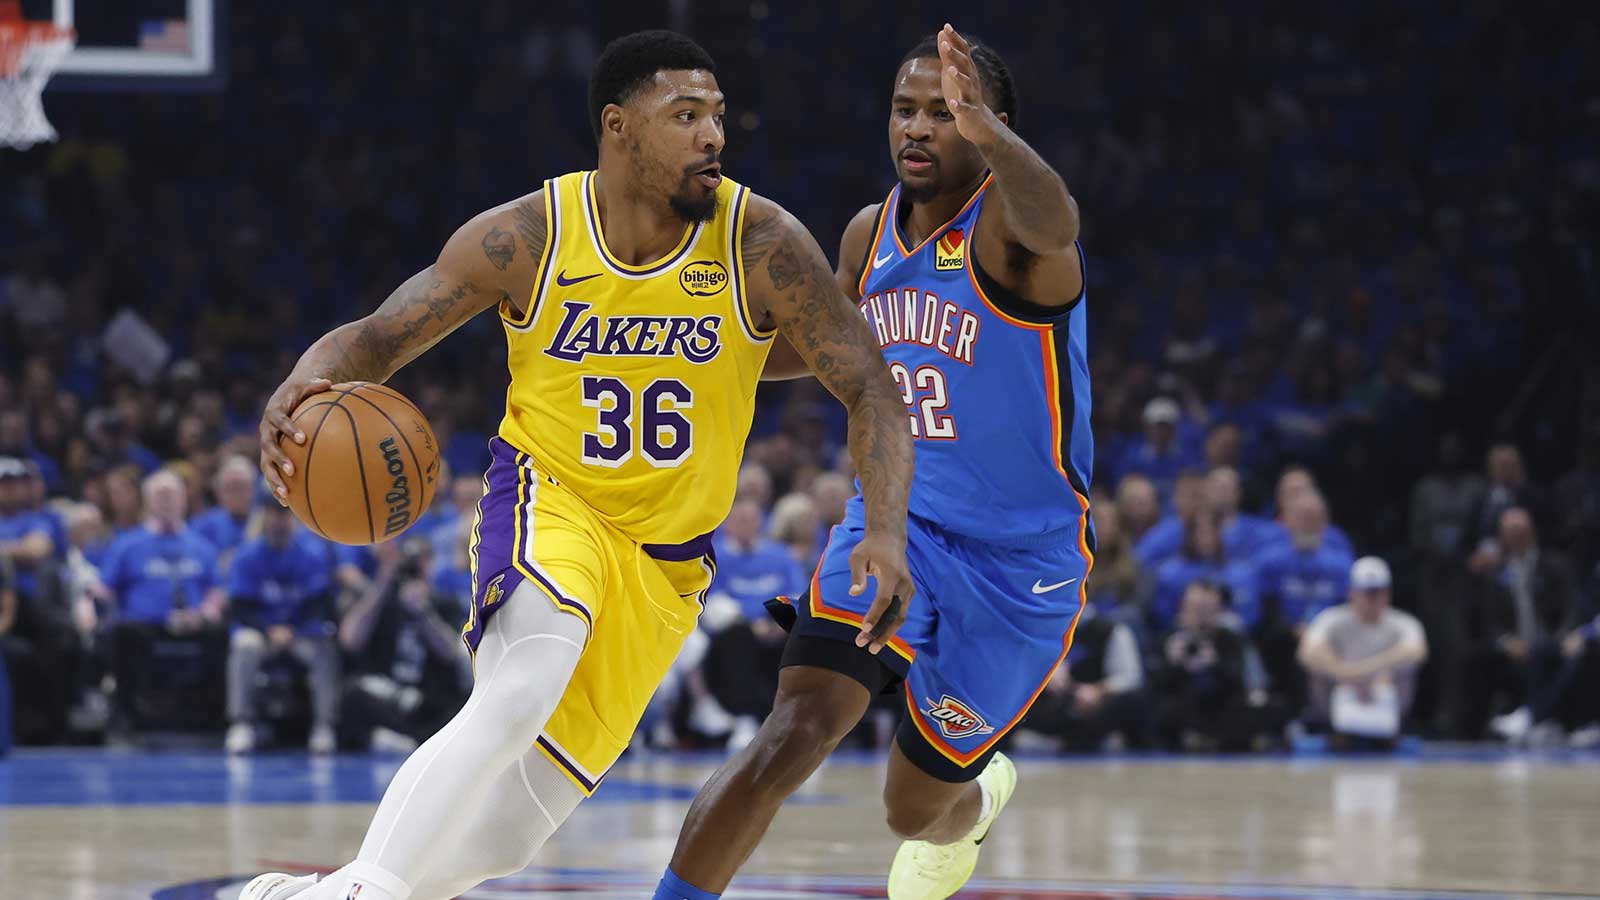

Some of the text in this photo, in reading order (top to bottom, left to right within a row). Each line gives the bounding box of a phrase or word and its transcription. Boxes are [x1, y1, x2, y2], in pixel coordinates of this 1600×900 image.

[684, 270, 726, 286] bibigo
[542, 300, 724, 366] LAKERS
[580, 375, 694, 469] 36
[889, 360, 958, 441] 22
[380, 436, 411, 537] Wilson
[929, 707, 977, 728] OKC
